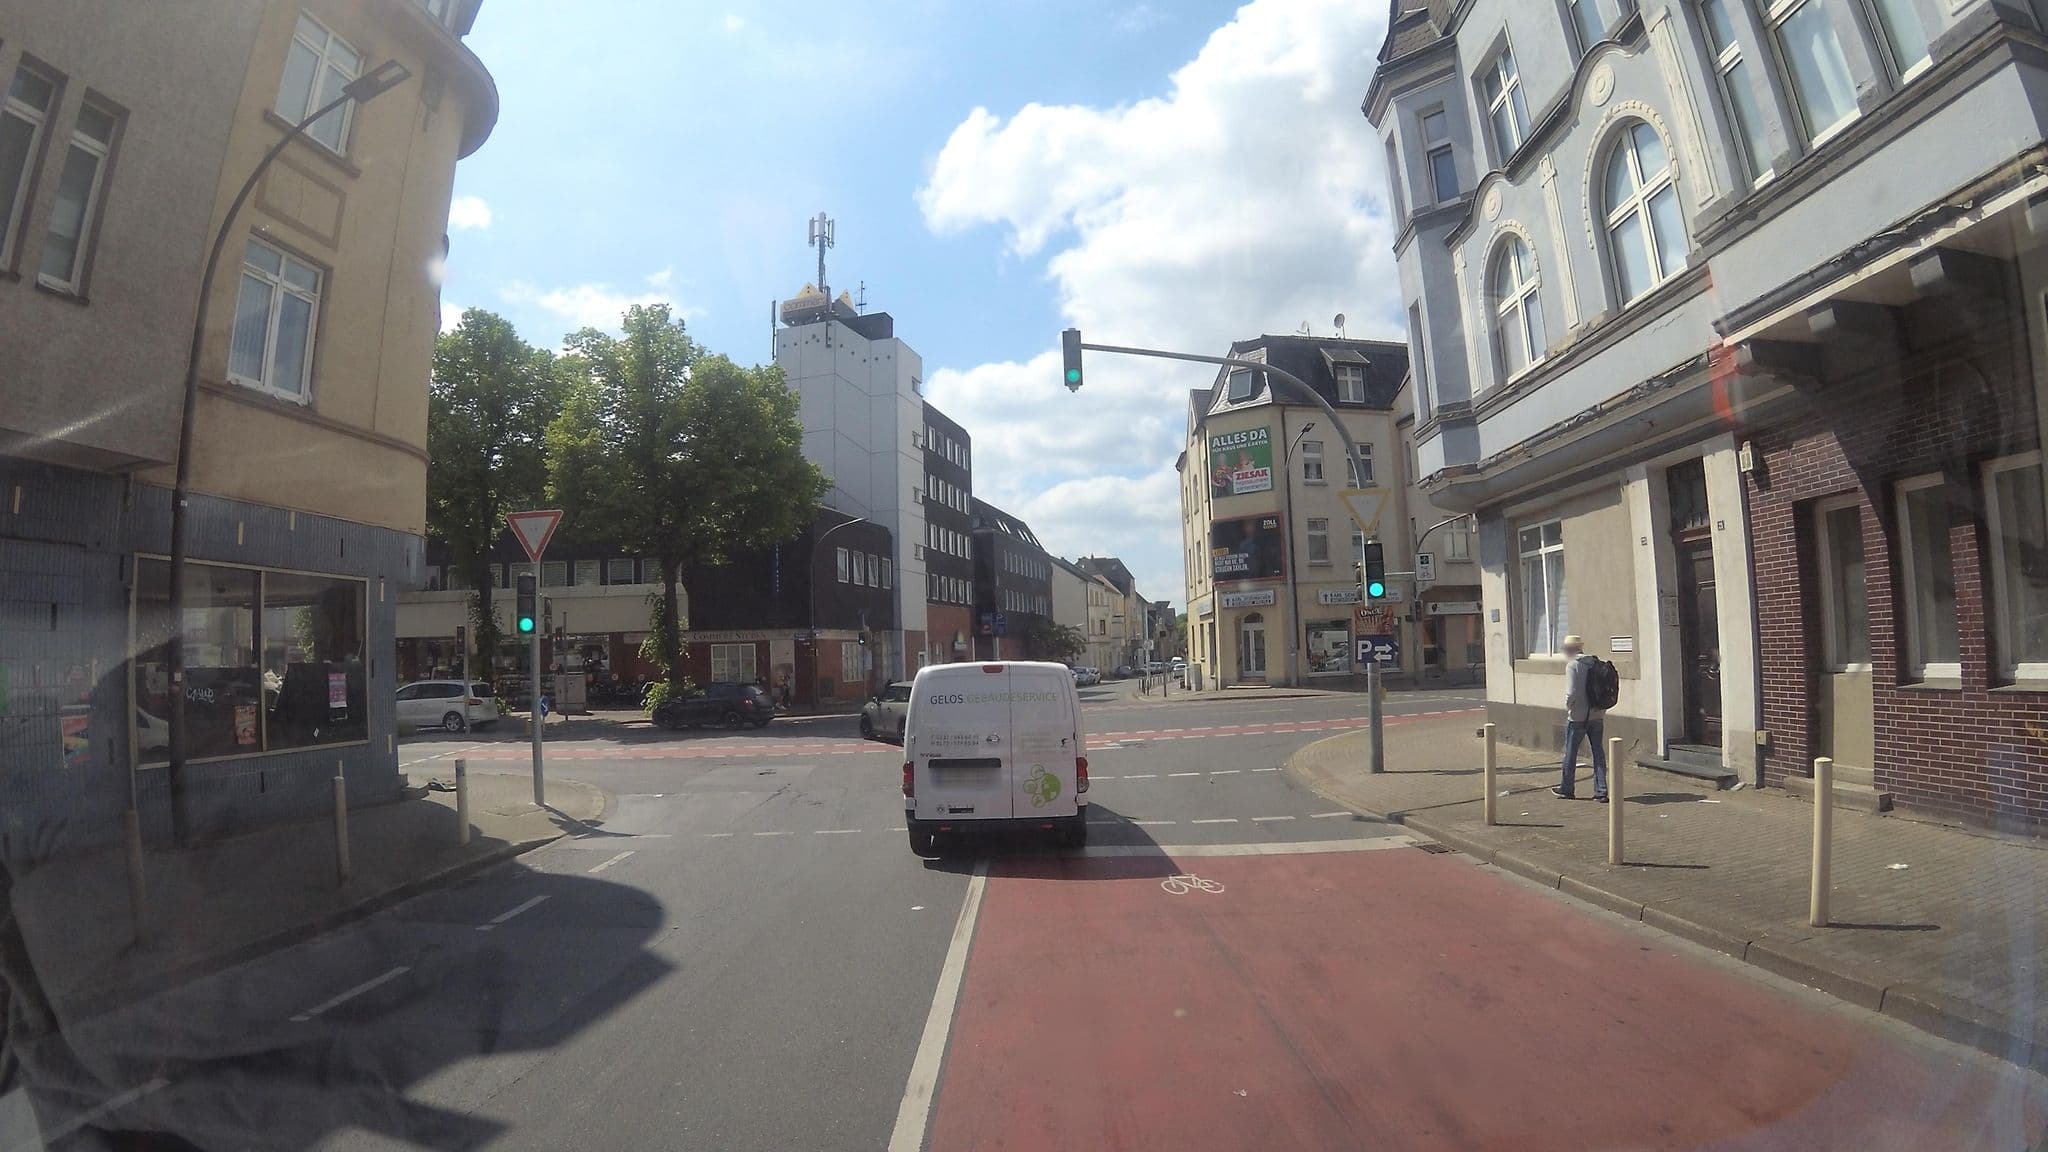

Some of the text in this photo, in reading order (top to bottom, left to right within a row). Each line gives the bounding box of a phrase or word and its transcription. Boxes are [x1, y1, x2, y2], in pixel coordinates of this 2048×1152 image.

[1212, 428, 1268, 448] ALLES DA
[1236, 468, 1268, 480] ZIESAK
[1357, 640, 1373, 660] P
[930, 694, 964, 705] GELOS
